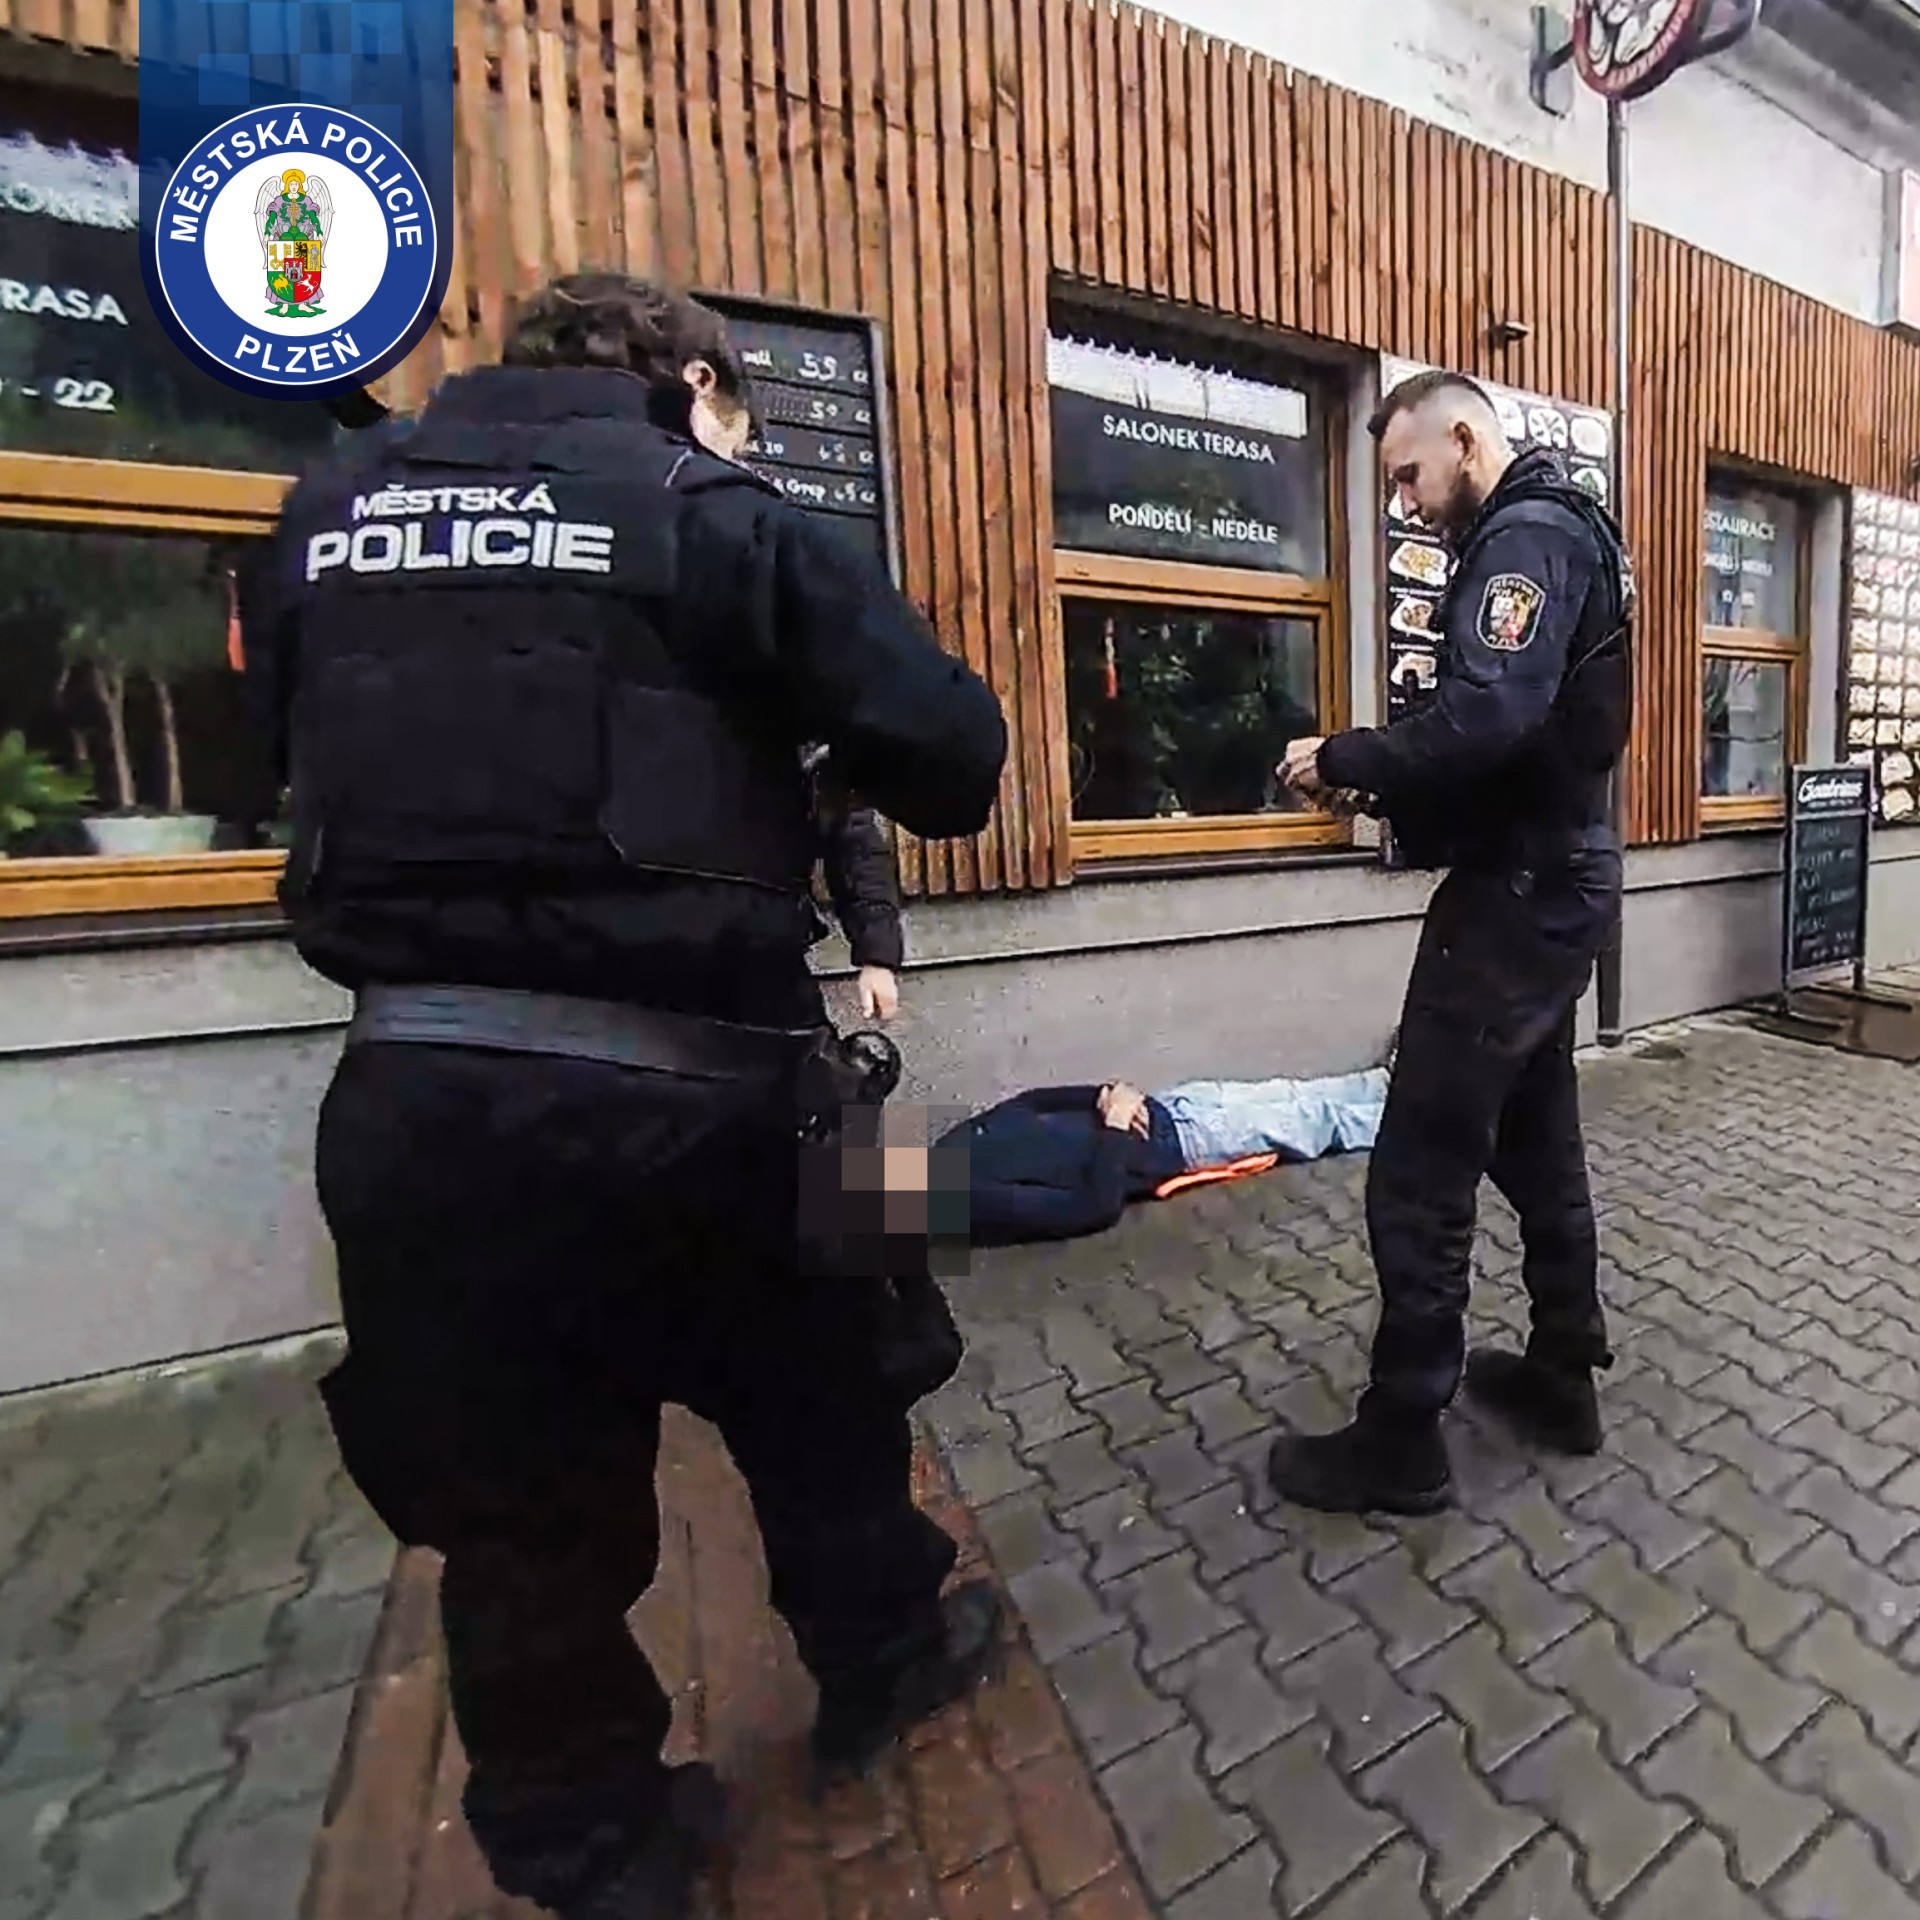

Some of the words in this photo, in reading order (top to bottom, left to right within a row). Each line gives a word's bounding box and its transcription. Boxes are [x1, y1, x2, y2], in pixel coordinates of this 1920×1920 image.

[53, 377, 117, 413] 22
[1103, 414, 1200, 451] SALONEK
[1202, 431, 1276, 465] TERASA
[352, 483, 557, 521] MĚSTSKÁ
[1212, 514, 1278, 544] NEDĚLE
[306, 519, 614, 582] POLICIE
